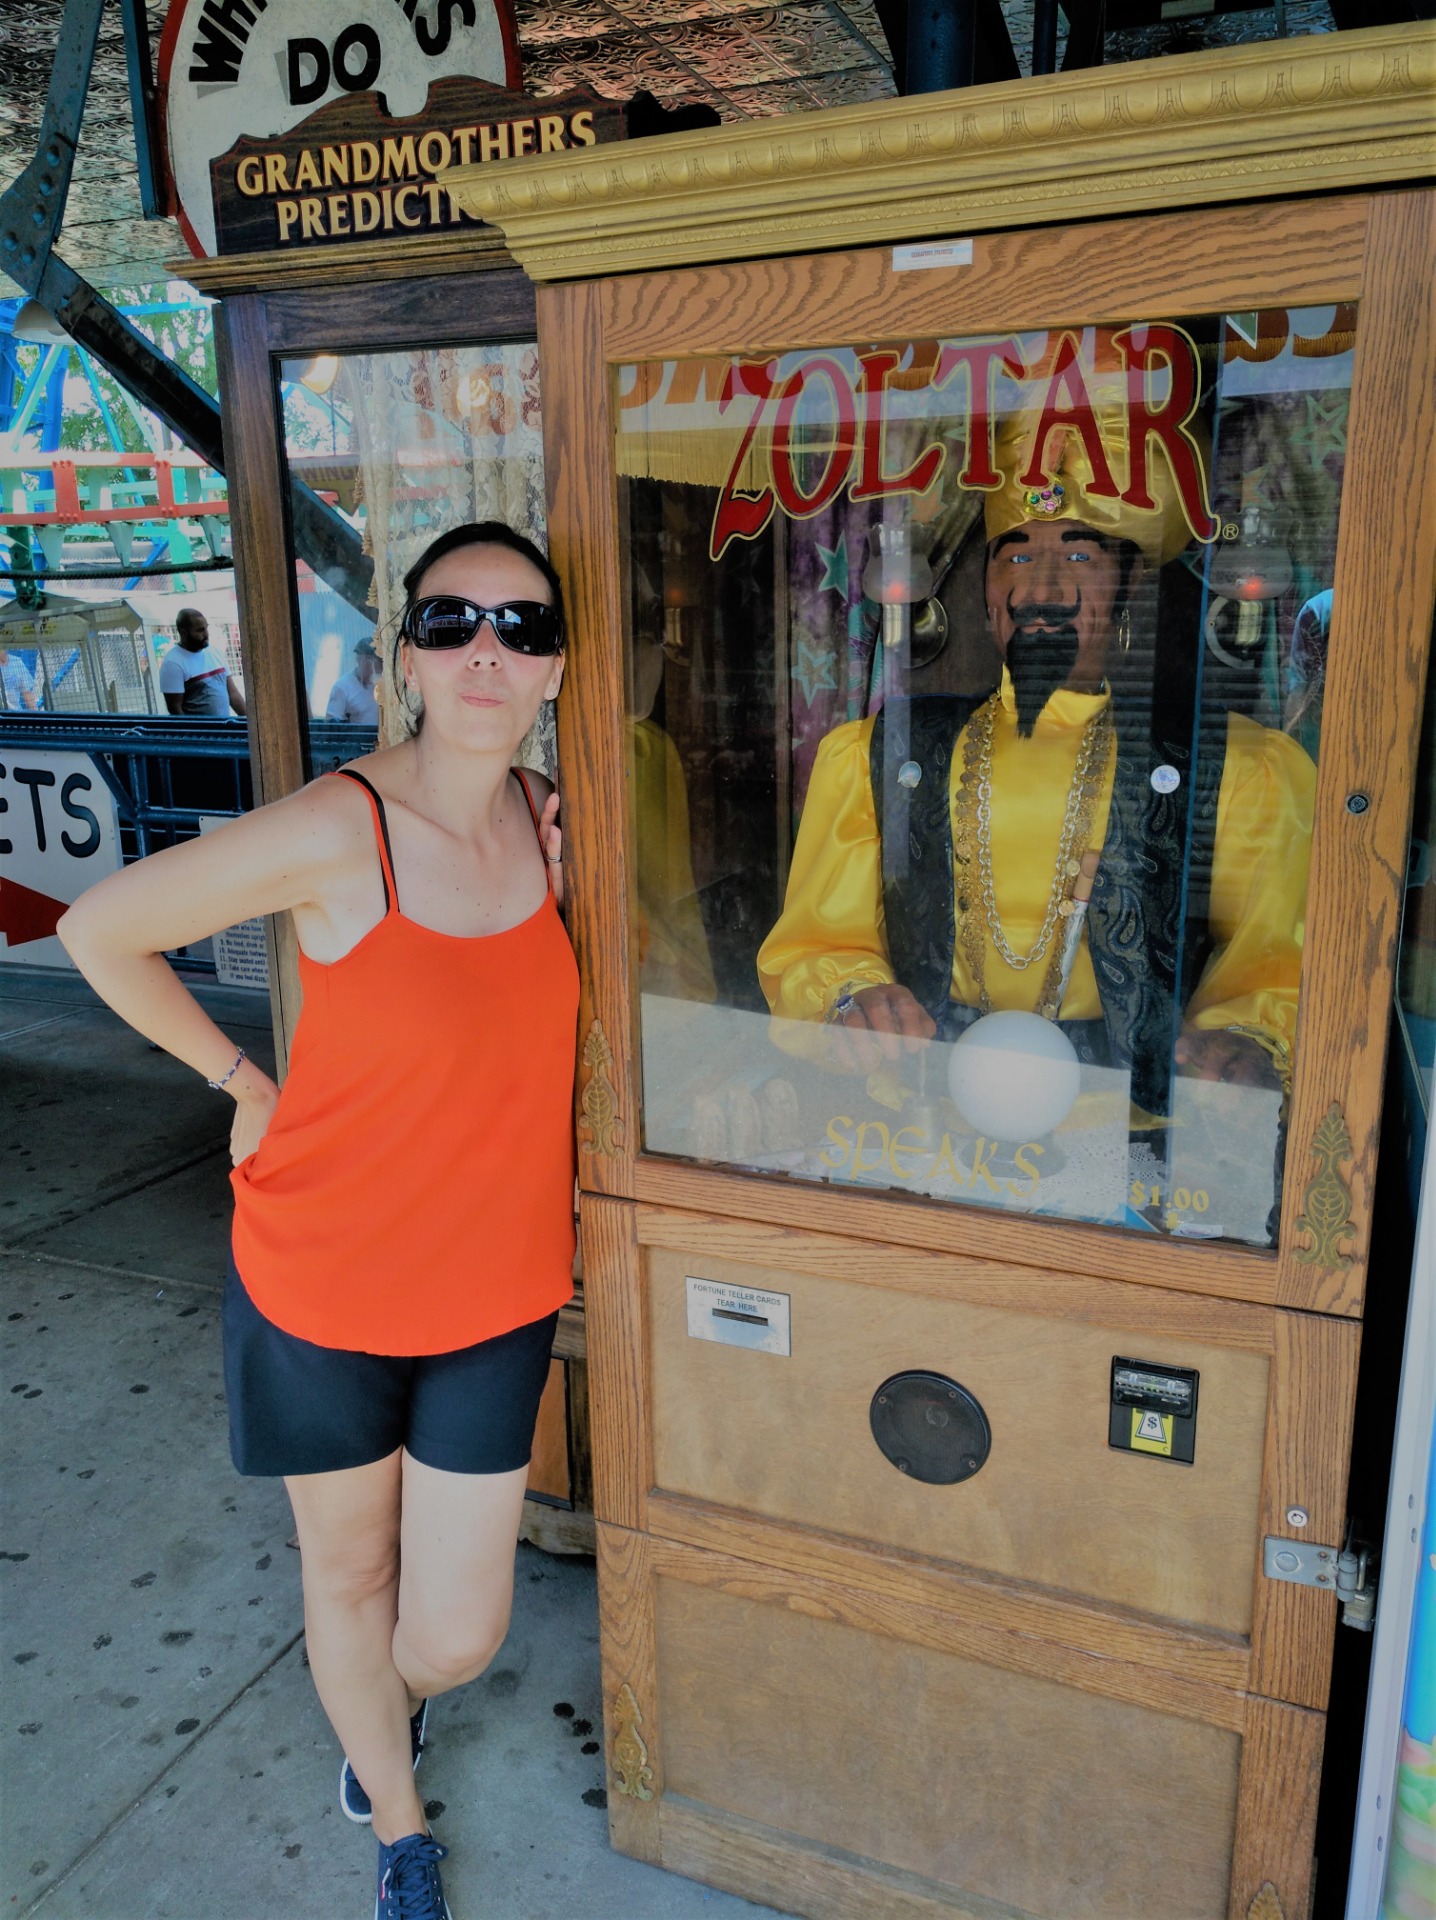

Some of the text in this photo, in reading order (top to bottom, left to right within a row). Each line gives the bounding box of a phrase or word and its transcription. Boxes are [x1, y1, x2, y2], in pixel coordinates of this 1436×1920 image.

[288, 23, 381, 106] DO
[236, 111, 597, 197] GRANDMOTHERS
[709, 322, 1221, 561] ZOLTAR
[819, 1115, 1046, 1198] SPEAKS
[1129, 1180, 1210, 1213] $1.00
[693, 1283, 781, 1306] FORTUNE TELLER CARDS
[717, 1298, 758, 1313] TEAR HERE
